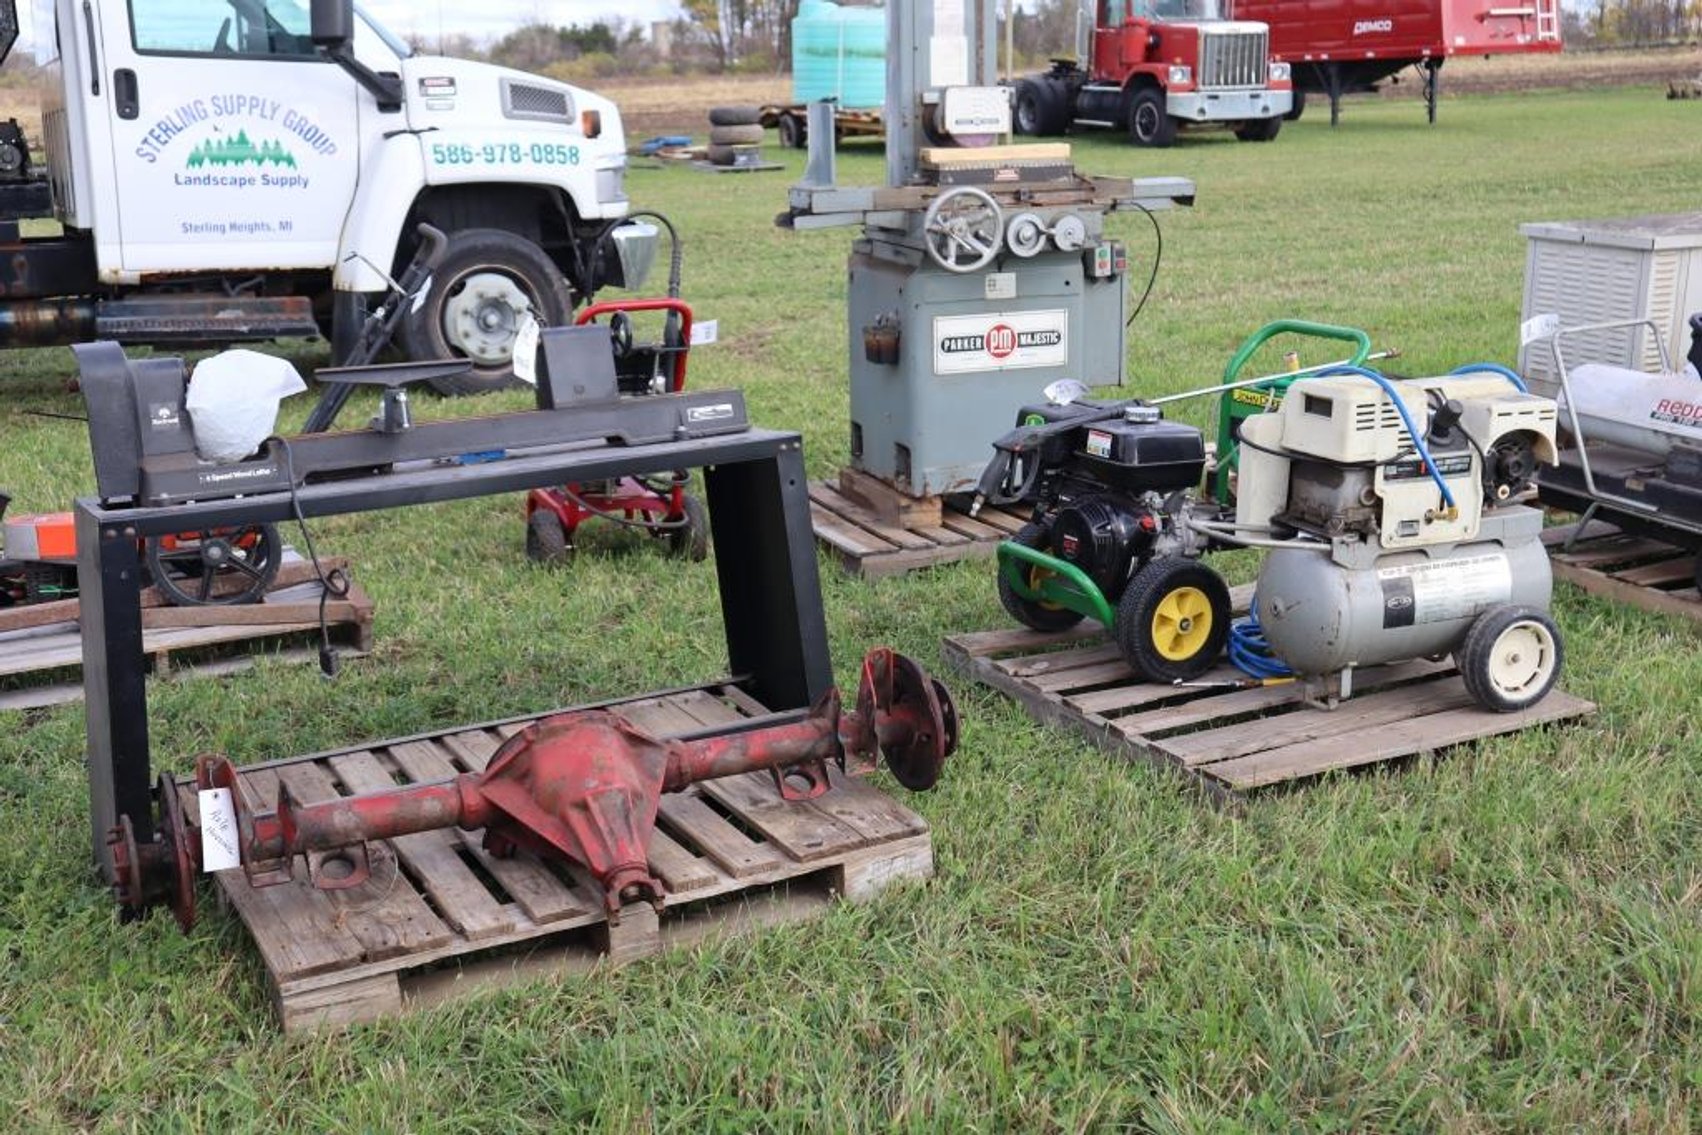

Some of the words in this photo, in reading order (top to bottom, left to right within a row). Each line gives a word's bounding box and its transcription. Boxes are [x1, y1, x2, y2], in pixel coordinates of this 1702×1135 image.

[1353, 20, 1392, 35] DEMCO
[136, 99, 208, 163] STERLING
[211, 95, 281, 121] SUPPLY
[283, 109, 338, 156] GROUP
[433, 143, 580, 165] 586-978-0858
[174, 173, 256, 188] Landscape
[261, 174, 308, 188] Supply
[182, 222, 225, 234] Sterling
[279, 221, 293, 232] MI
[943, 337, 983, 351] PARKER
[1020, 333, 1058, 345] MAJESTIC
